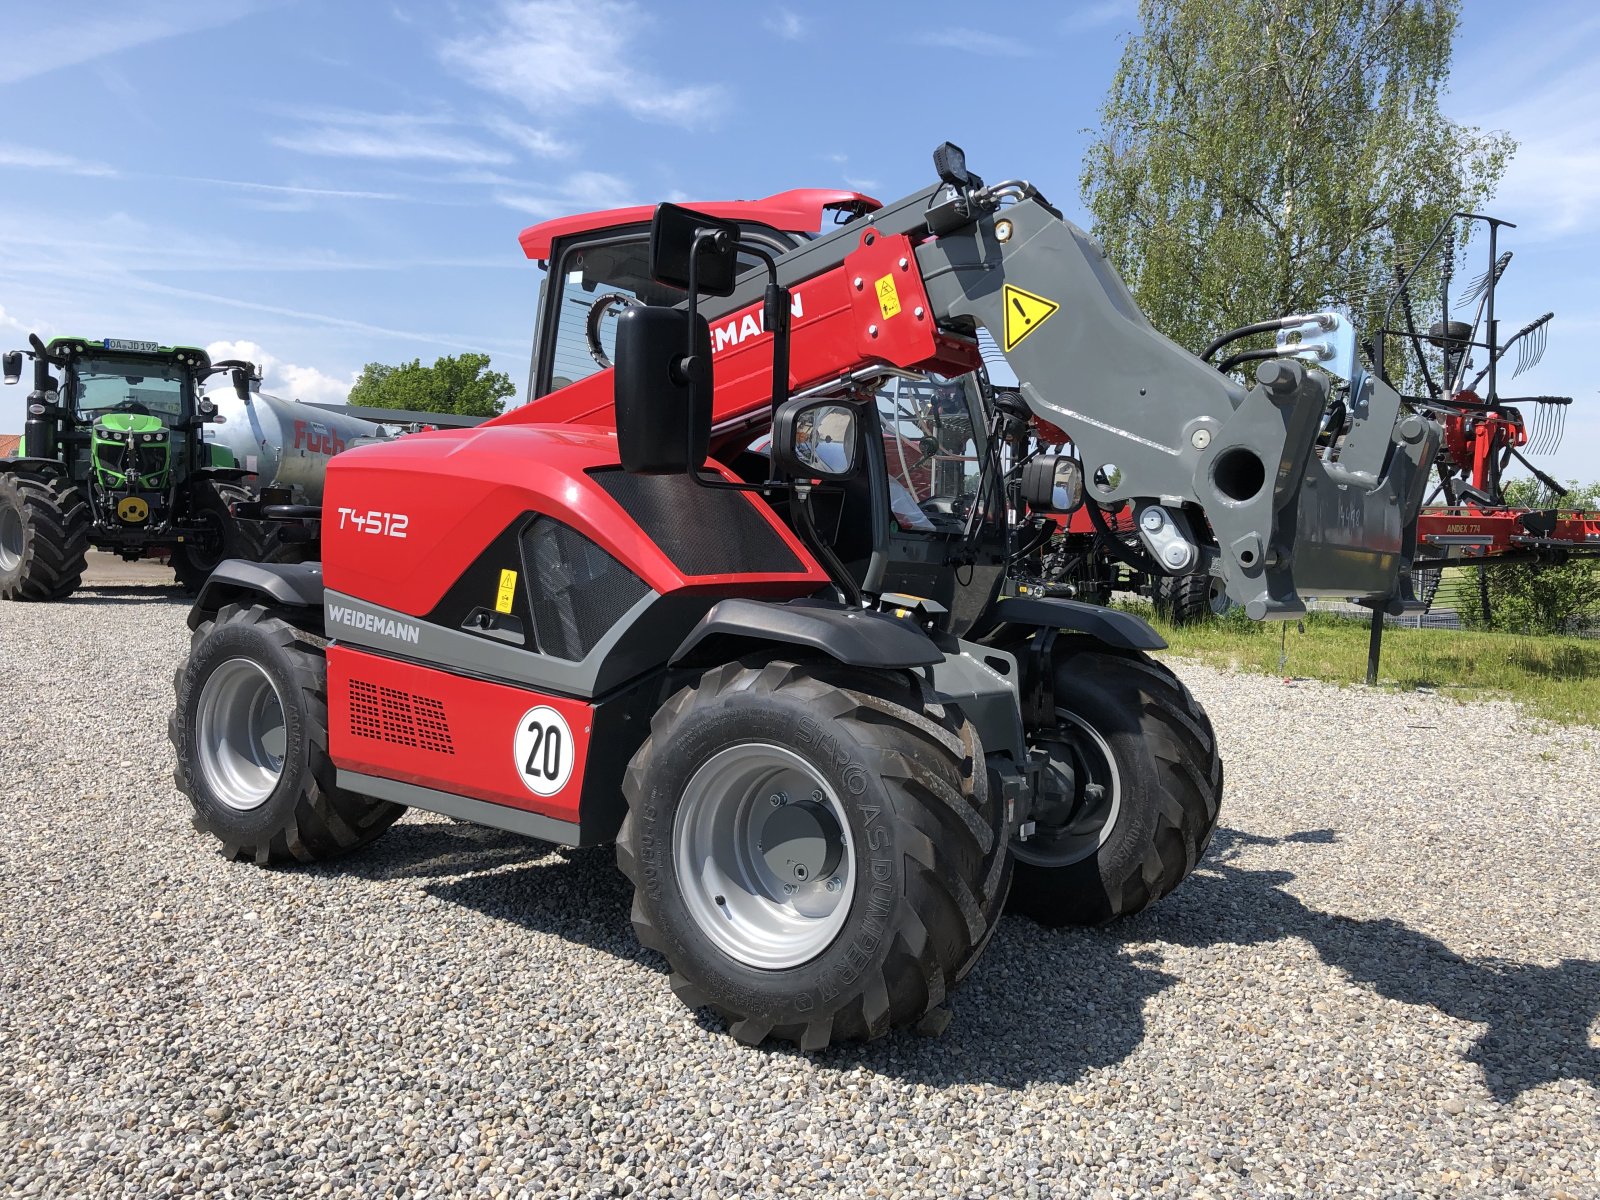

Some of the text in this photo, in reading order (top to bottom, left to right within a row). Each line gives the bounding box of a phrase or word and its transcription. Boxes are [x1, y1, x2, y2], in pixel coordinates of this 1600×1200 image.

[110, 340, 122, 349] OA
[140, 342, 157, 351] 192
[338, 507, 408, 538] T4512
[1446, 524, 1481, 533] ANDEX 774
[328, 604, 420, 644] WEIDEMANN
[525, 721, 562, 781] 20
[857, 804, 891, 851] AS
[833, 859, 894, 985] DUMPER
